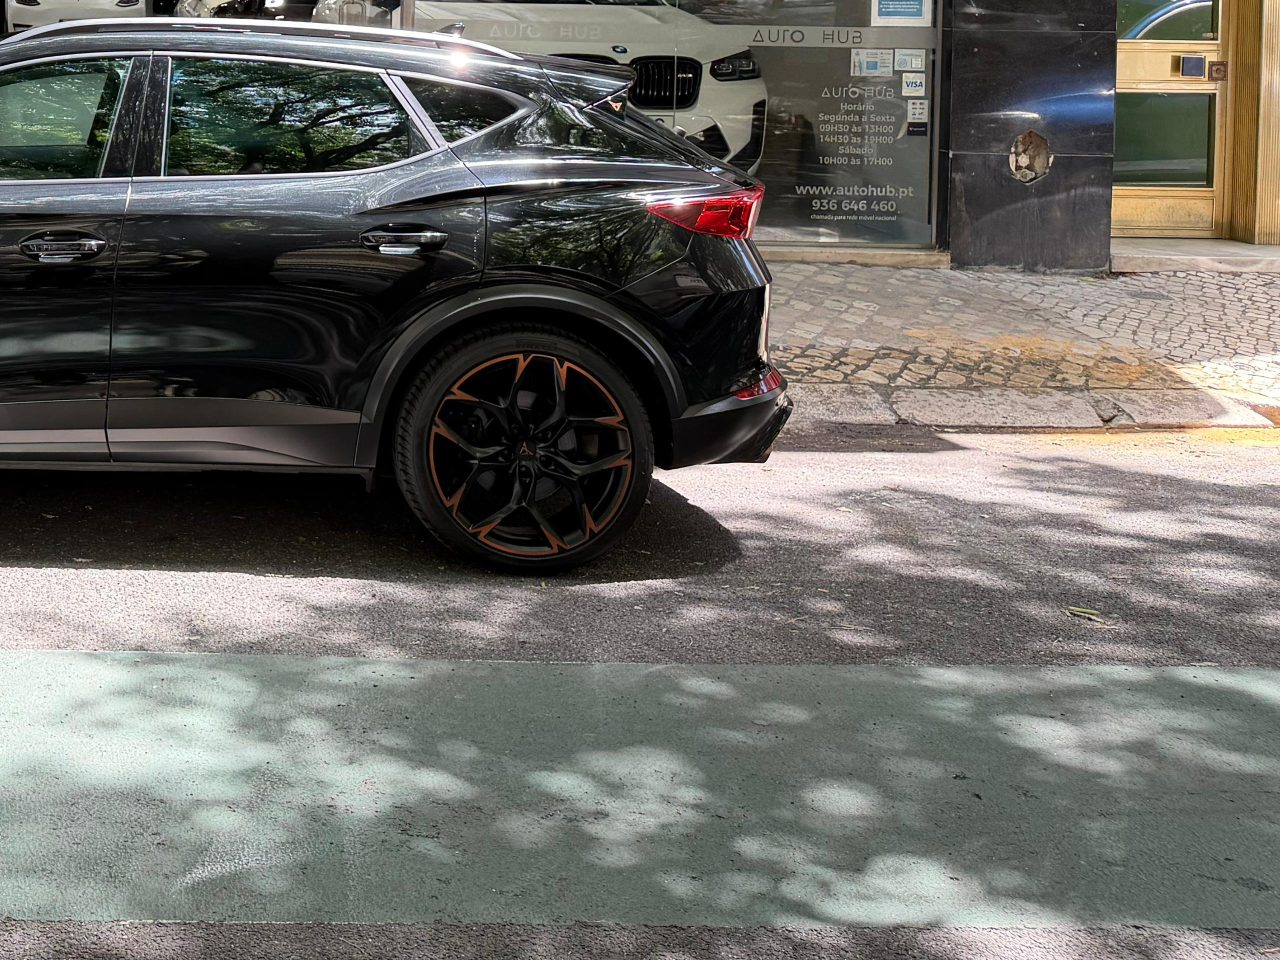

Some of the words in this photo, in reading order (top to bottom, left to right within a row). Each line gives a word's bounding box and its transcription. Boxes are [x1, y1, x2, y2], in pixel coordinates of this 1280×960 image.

[752, 28, 805, 44] AUTO
[822, 29, 863, 45] HUB
[821, 87, 860, 99] AUTO
[864, 86, 895, 99] HUB
[840, 102, 875, 111] Horário
[818, 113, 860, 123] Segunda
[869, 114, 895, 122] Sexta
[819, 124, 849, 133] 09H30
[851, 124, 862, 133] às
[864, 125, 894, 134] 13H00
[819, 134, 849, 143] 14H30
[850, 134, 861, 144] às
[864, 135, 894, 144] 19H00
[838, 145, 874, 155] Sábado
[818, 156, 848, 165] 10H00
[850, 156, 861, 165] às
[863, 157, 893, 166] 17H00
[795, 184, 914, 199] www.autohub.pt
[811, 199, 838, 210] 936
[841, 199, 867, 211] 646
[870, 200, 897, 212] 460
[858, 213, 875, 221] móvel
